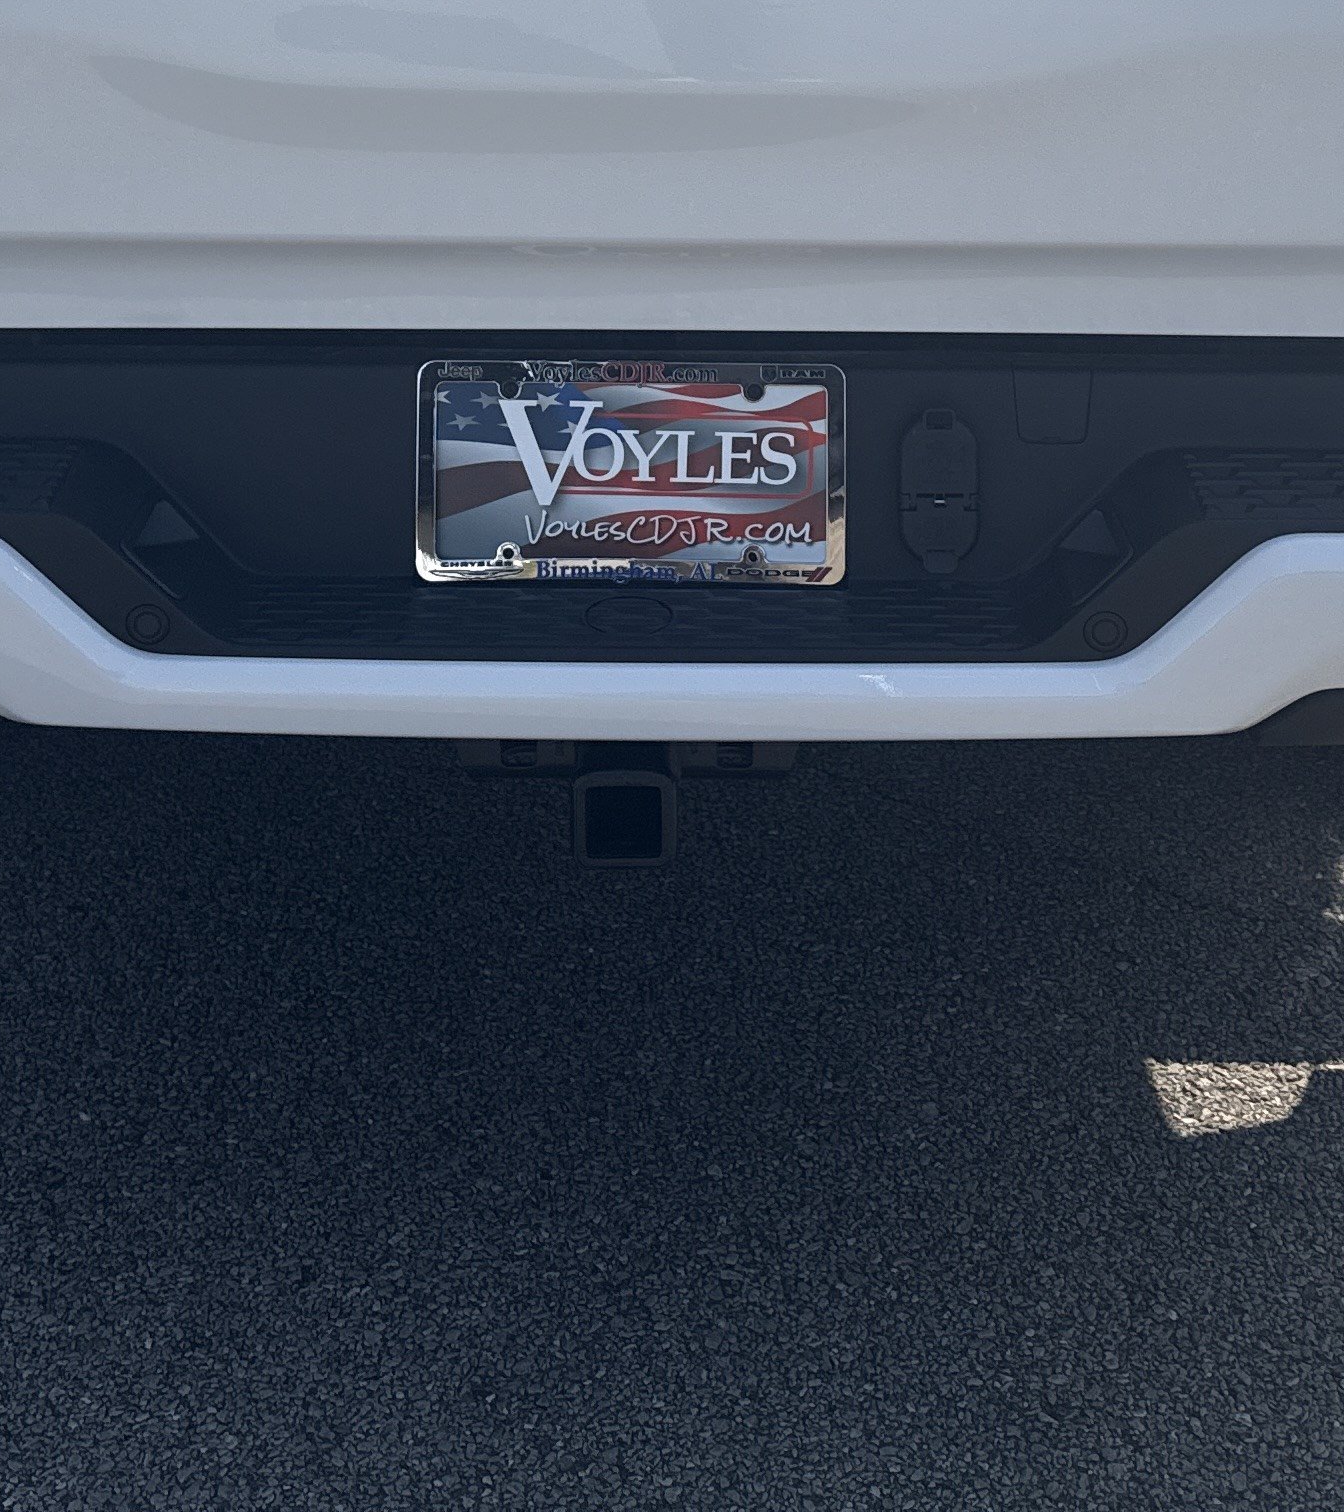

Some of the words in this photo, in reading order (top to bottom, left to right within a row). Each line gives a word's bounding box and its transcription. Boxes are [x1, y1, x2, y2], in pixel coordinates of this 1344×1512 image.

[438, 361, 484, 381] Jeep
[779, 369, 826, 379] RAM
[499, 399, 798, 506] VOYLES
[536, 559, 683, 583] Birmingham,
[690, 561, 724, 581] AL
